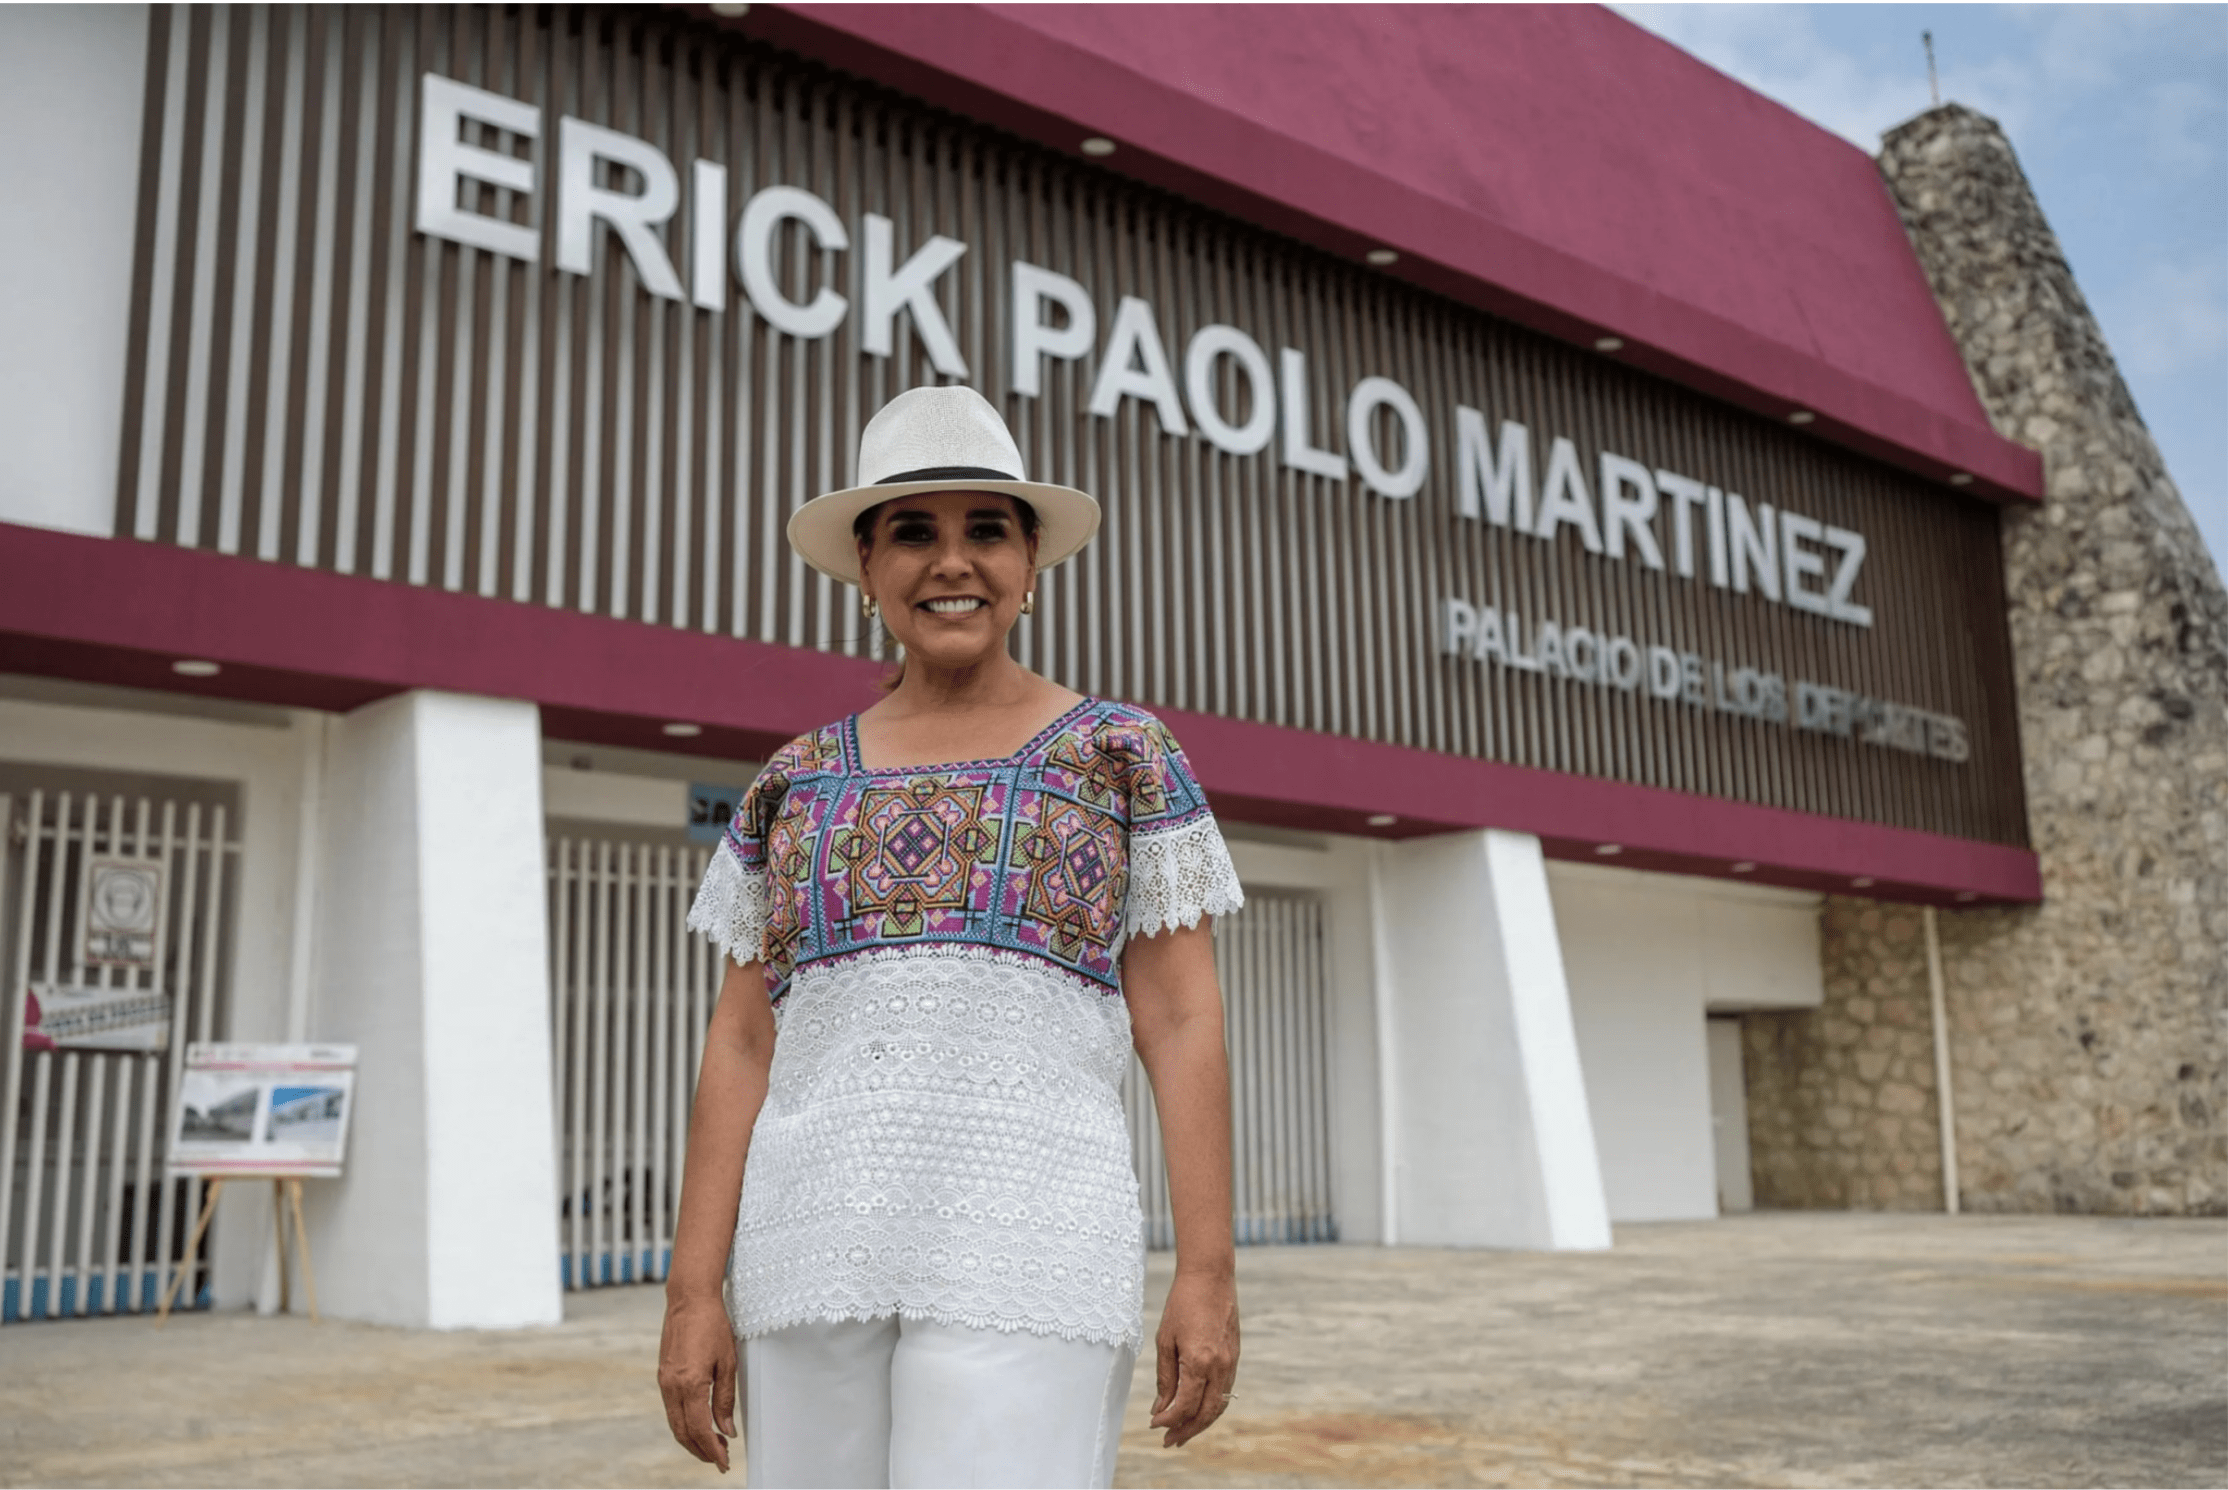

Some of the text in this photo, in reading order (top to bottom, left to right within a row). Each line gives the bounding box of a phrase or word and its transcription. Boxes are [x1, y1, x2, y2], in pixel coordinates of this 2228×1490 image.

[416, 72, 1872, 629] ERICK PAOLO MARTINEZ
[1445, 598, 1642, 690] PALACIO
[1650, 645, 1705, 706] DE
[1713, 658, 1788, 723] LOS
